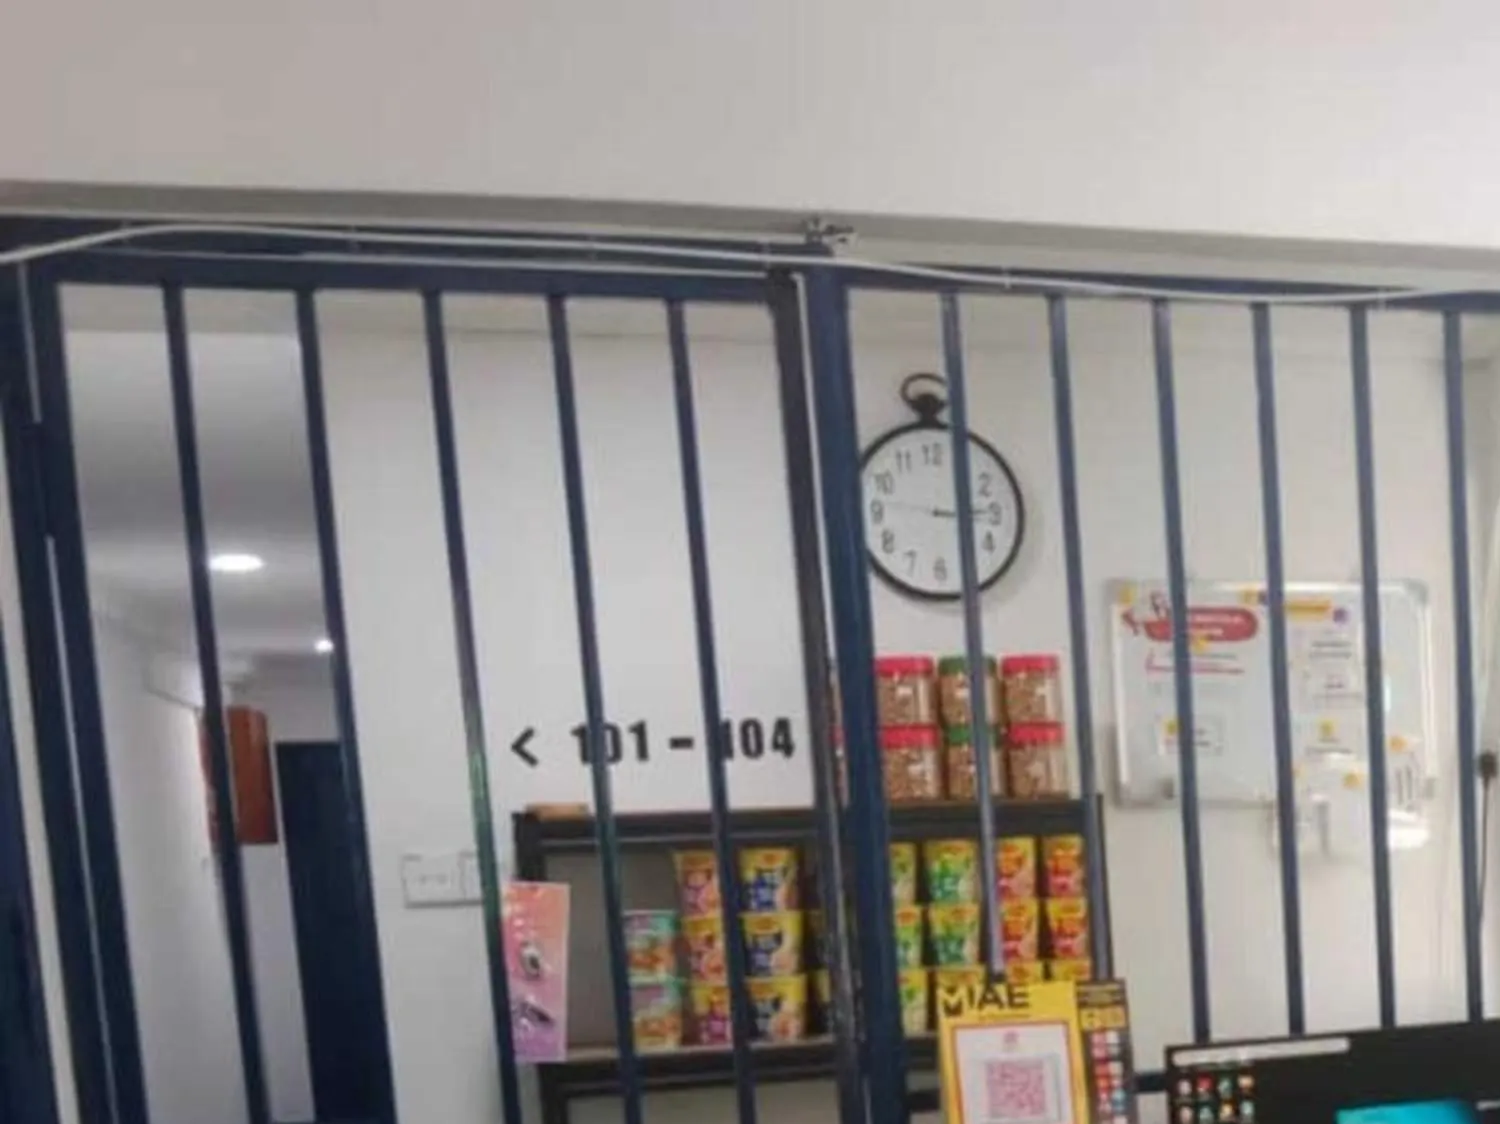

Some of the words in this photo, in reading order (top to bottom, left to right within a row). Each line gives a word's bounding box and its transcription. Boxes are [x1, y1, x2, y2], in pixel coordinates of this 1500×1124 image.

[896, 450, 912, 473] 11
[921, 442, 943, 466] 12
[874, 472, 895, 496] 10
[978, 472, 992, 498] 2
[870, 500, 884, 525] 9
[881, 529, 895, 554] 8
[982, 529, 996, 555] 4
[904, 550, 918, 577] 7
[933, 556, 948, 582] 6
